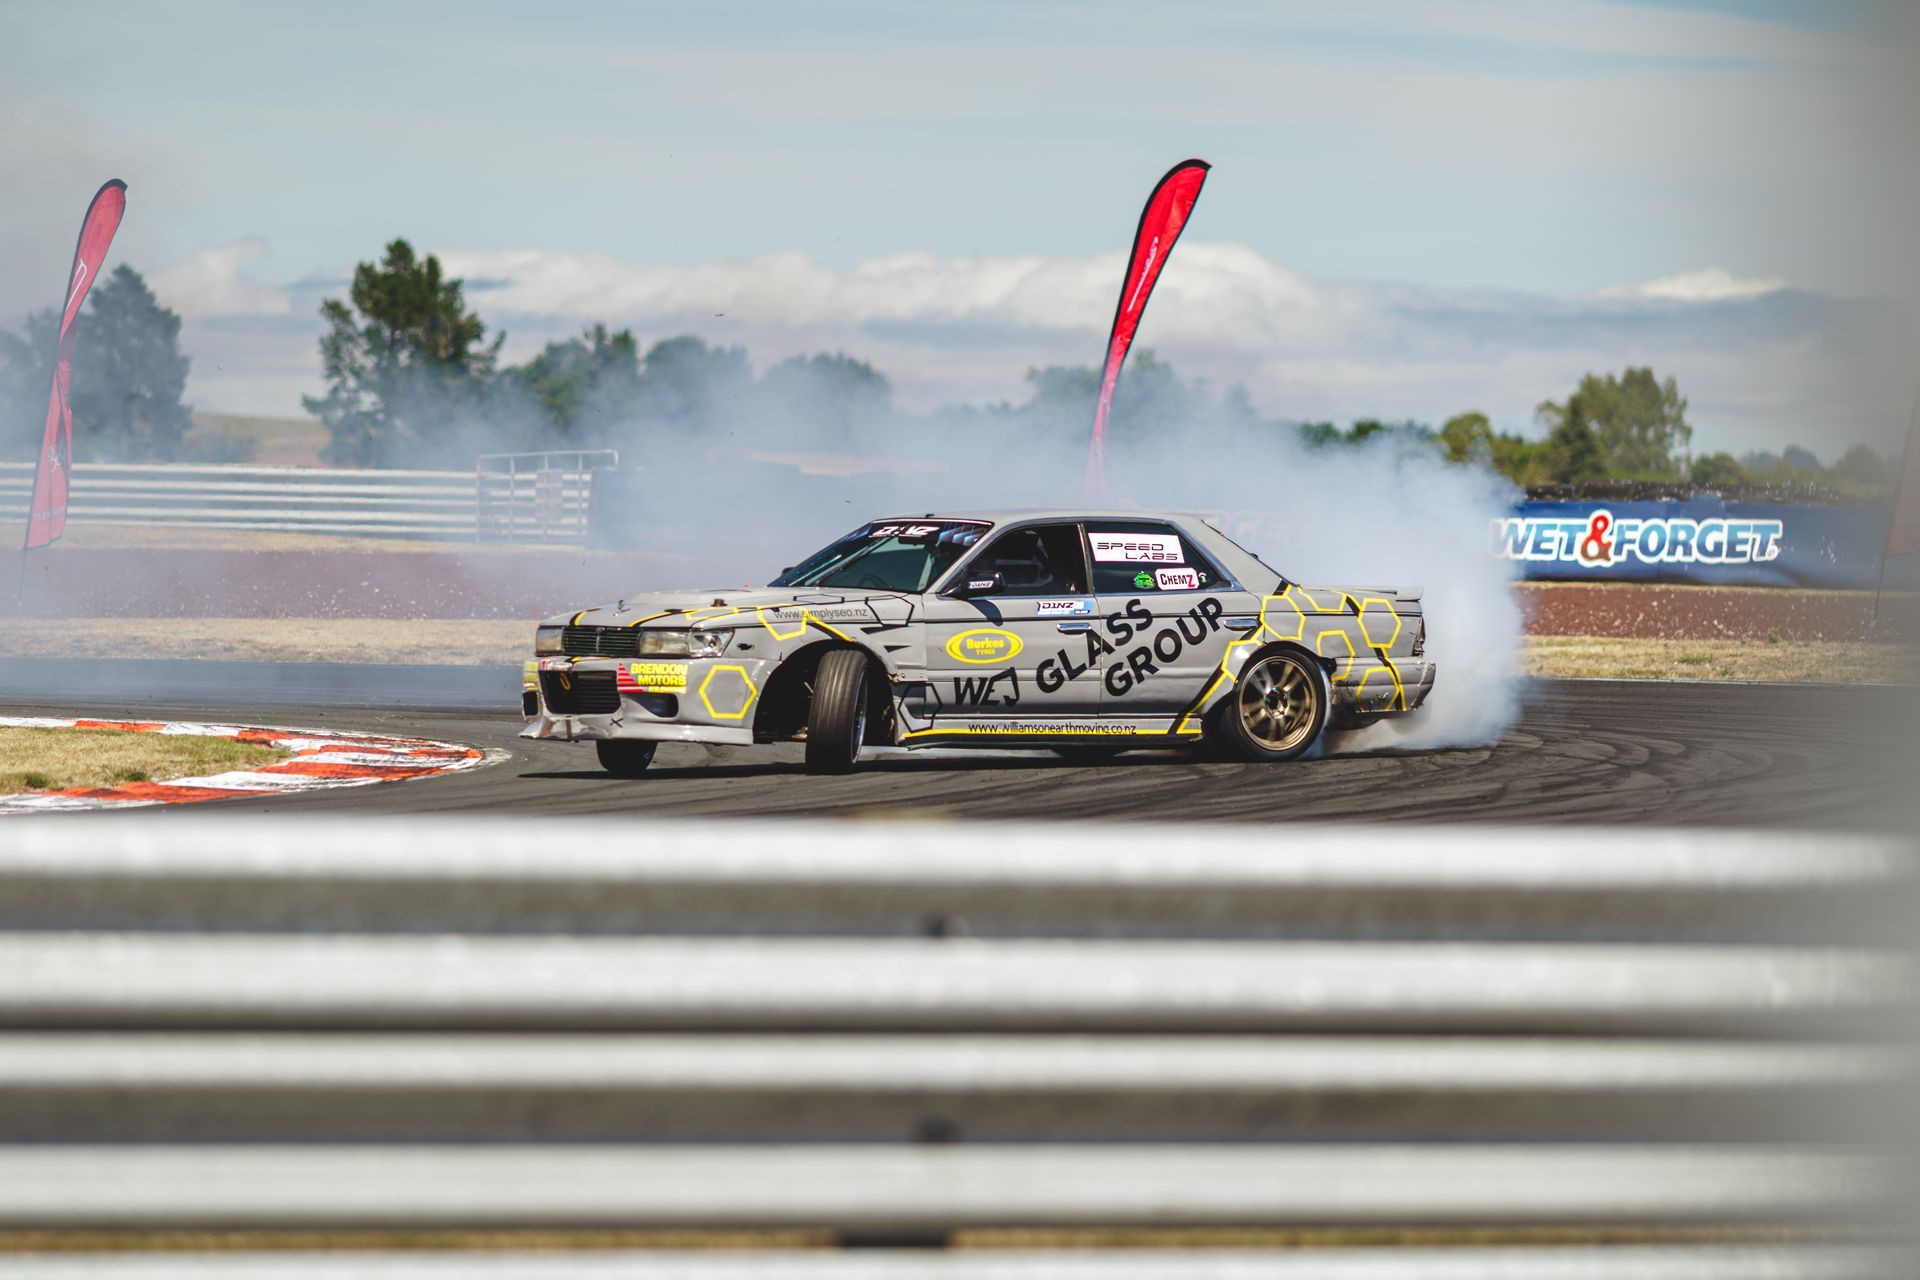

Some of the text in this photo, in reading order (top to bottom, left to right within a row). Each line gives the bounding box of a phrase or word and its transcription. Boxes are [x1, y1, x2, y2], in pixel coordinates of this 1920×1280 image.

[1096, 542, 1164, 551] SPEED
[1125, 552, 1178, 561] LABS
[1036, 598, 1153, 694] GLASS
[1104, 597, 1223, 697] GROUP
[630, 663, 689, 675] BRENDON
[638, 674, 687, 686] MOTORS
